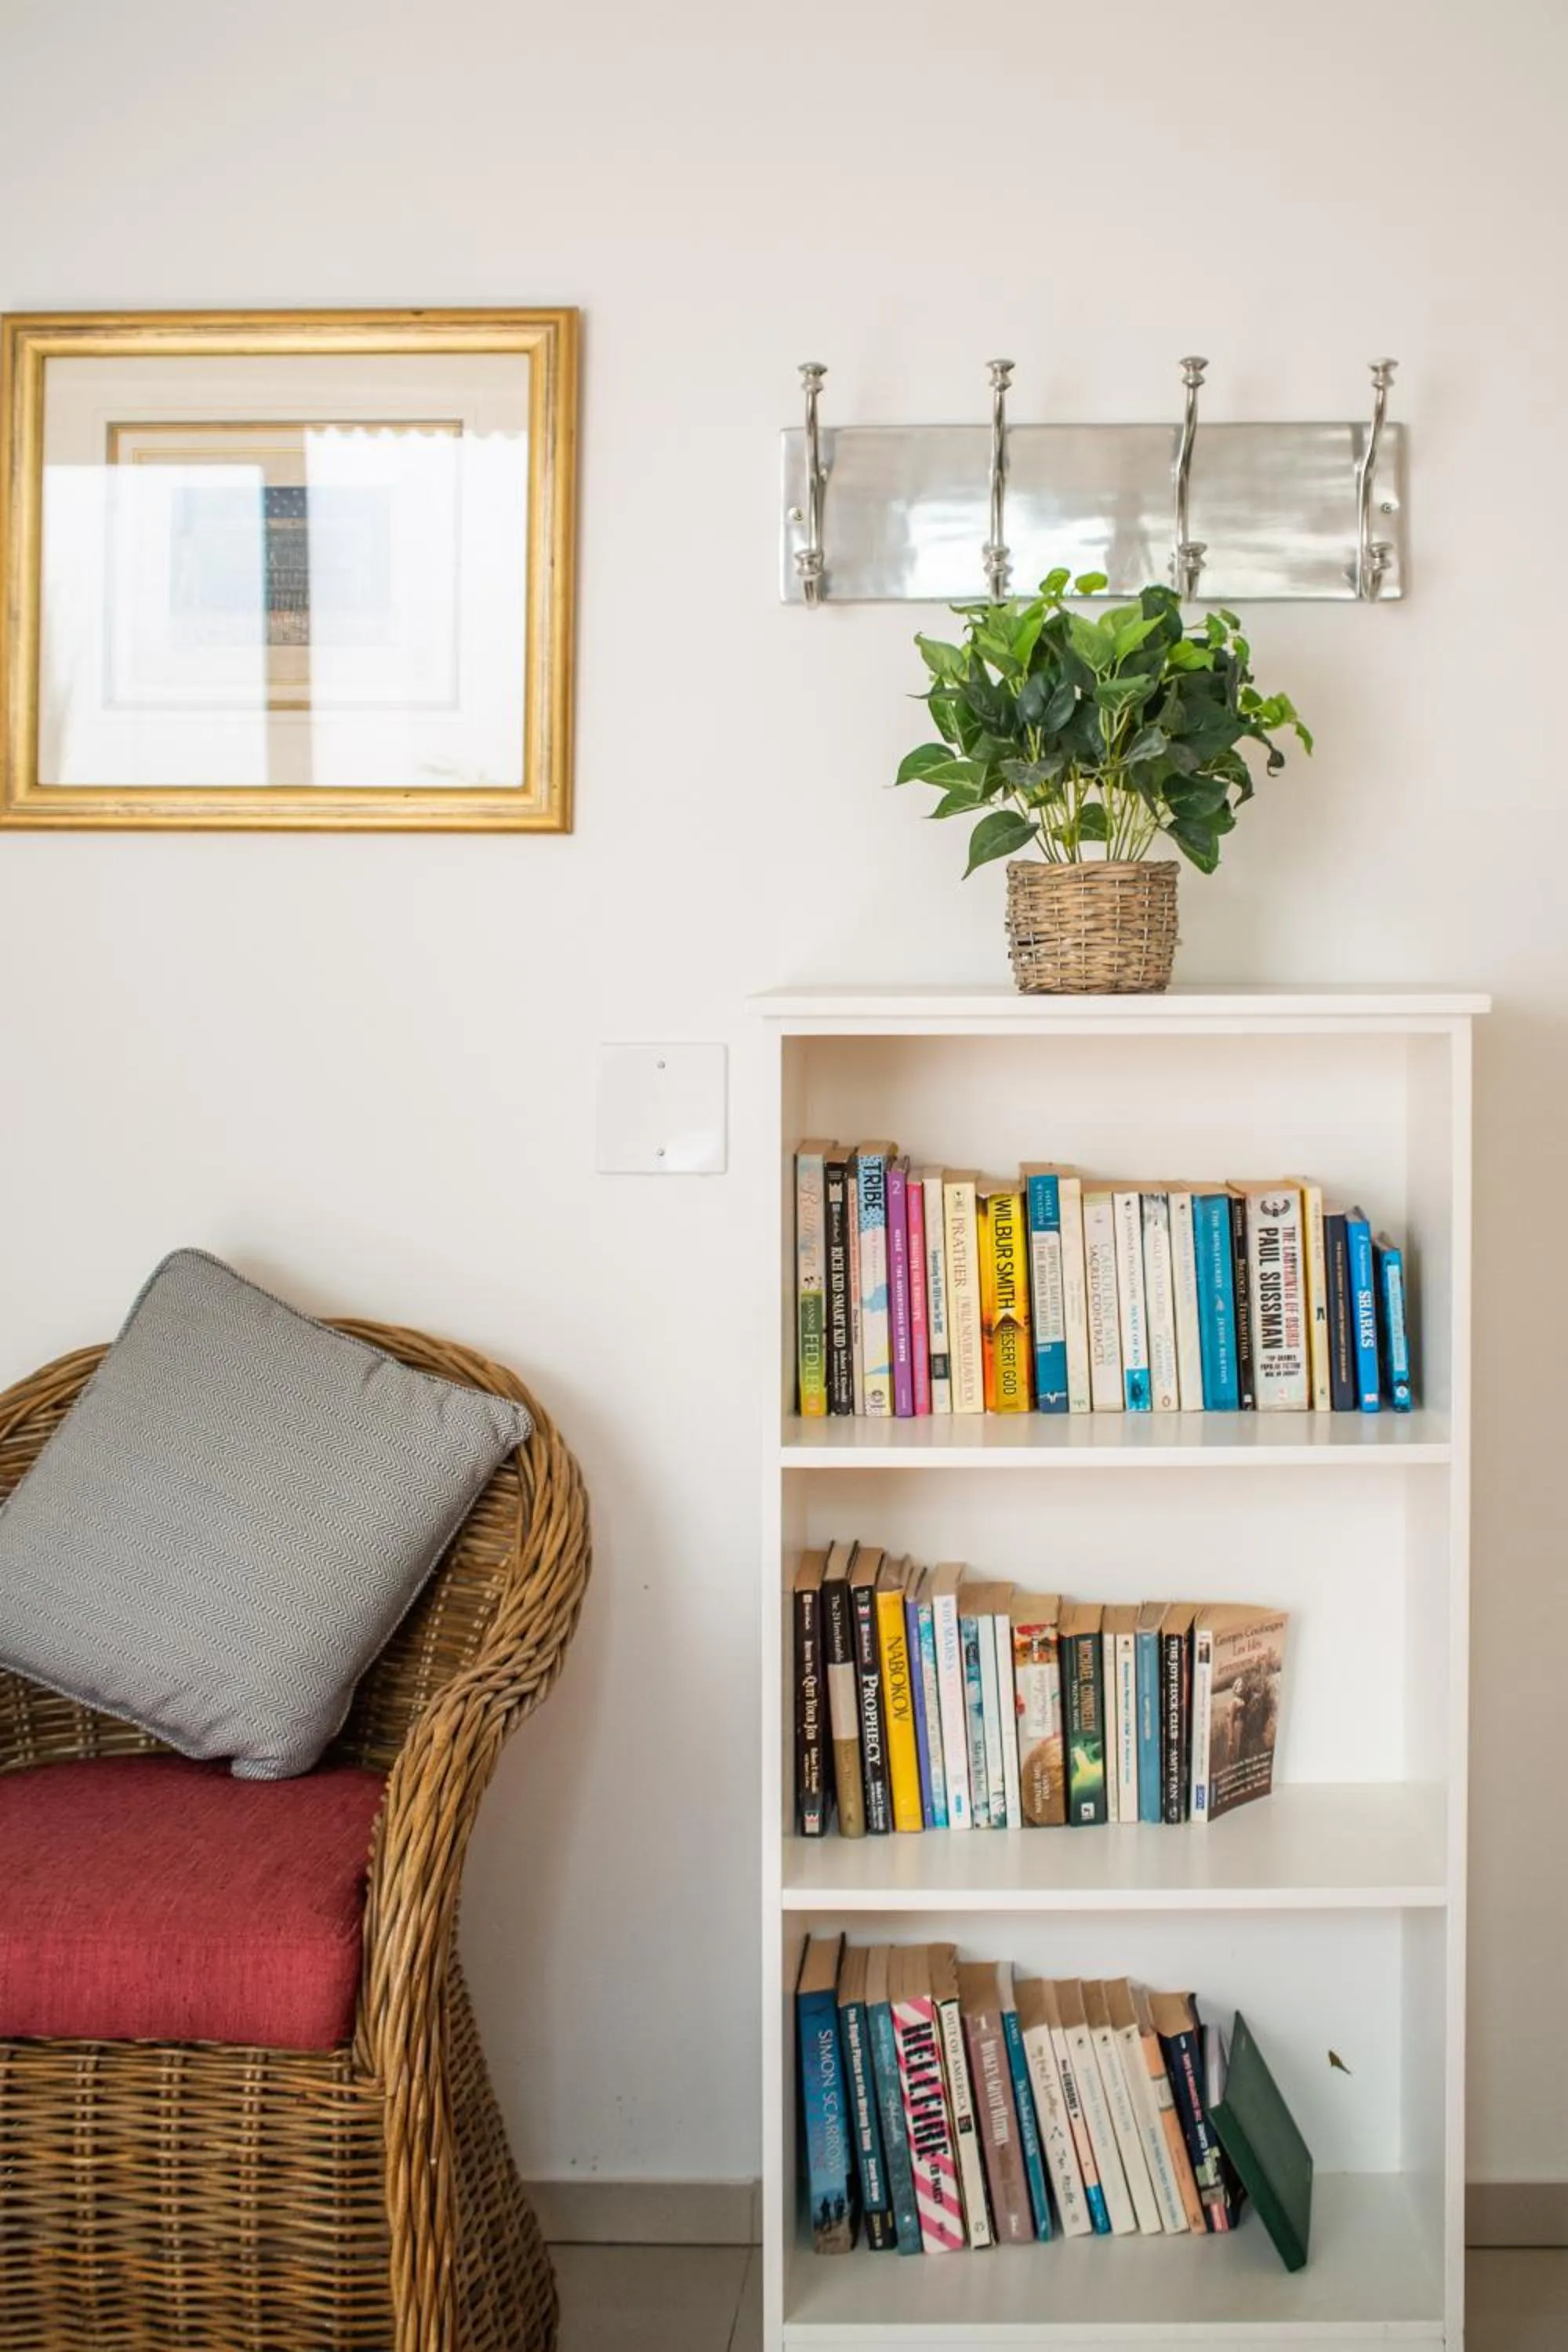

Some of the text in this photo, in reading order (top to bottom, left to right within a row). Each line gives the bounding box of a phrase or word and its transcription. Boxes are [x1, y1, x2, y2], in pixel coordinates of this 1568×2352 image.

[864, 1162, 883, 1211] TRIBE
[891, 1179, 902, 1196] 2
[952, 1217, 967, 1290] PRATHER
[995, 1199, 1015, 1309] WILBUR SMITH
[1281, 1226, 1296, 1243] THE
[831, 1247, 844, 1271] RICH
[1283, 1246, 1298, 1298] LABYRINTH
[832, 1272, 844, 1292] KID
[1258, 1228, 1283, 1349] PAUL SUSSMAN
[833, 1294, 844, 1327] SMART
[1089, 1244, 1105, 1367] SACRED CONTRACTS
[1102, 1243, 1117, 1367] CAROLINE MYSS
[1358, 1290, 1374, 1348] SHARKS
[833, 1329, 845, 1347] KID
[1286, 1316, 1300, 1348] OSIRIS
[804, 1334, 819, 1394] FEDLER
[1000, 1325, 1017, 1395] DESERT GOD
[830, 1595, 840, 1610] The
[942, 1626, 955, 1662] MARS
[803, 1675, 817, 1697] QUIT
[886, 1635, 909, 1722] NABOKOV
[1078, 1639, 1095, 1732] MICHAEL CONNELLY
[1168, 1661, 1179, 1682] JOY
[805, 1700, 818, 1722] YOUR
[1169, 1683, 1179, 1711] LUCK
[804, 1724, 819, 1740] JOB
[862, 1674, 880, 1766] PROPHECY
[1170, 1748, 1179, 1771] AMY
[945, 2011, 967, 2111] OUT OF AMERICA
[818, 2029, 840, 2174] SIMON SCARROW
[902, 2021, 949, 2162] HELLFIRE
[931, 2178, 944, 2205] MACY
